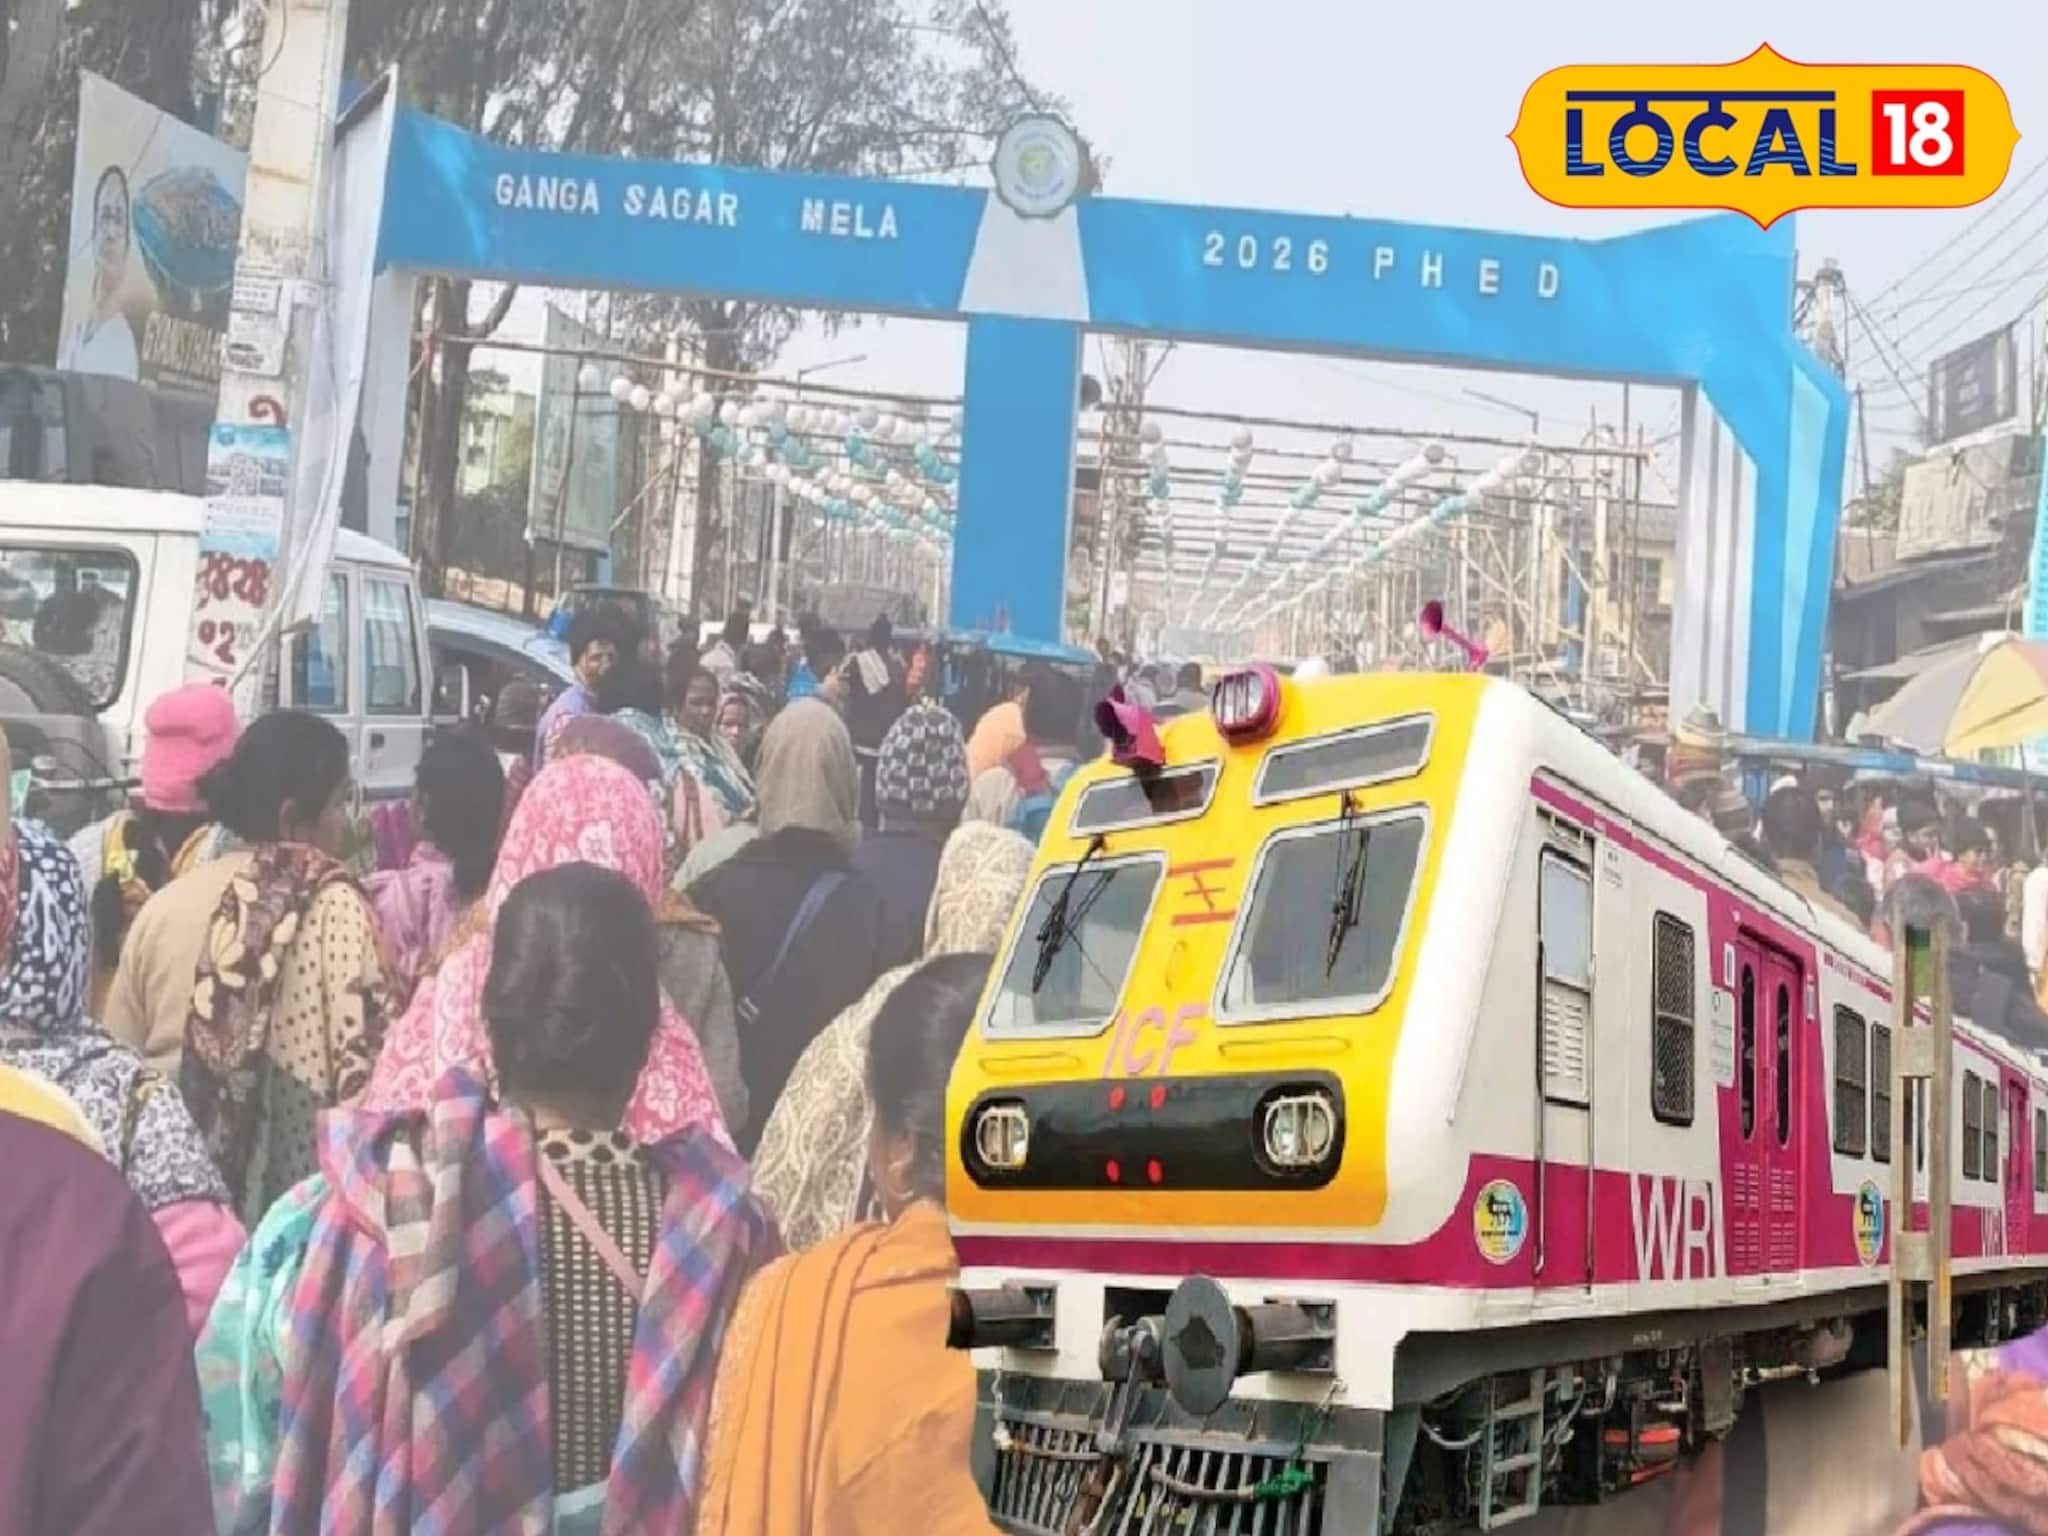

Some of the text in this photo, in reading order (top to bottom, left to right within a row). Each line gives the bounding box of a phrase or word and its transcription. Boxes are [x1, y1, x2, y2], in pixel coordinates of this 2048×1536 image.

[496, 173, 600, 215] GANGA
[623, 184, 738, 227] SAGAR
[801, 198, 898, 238] MELA
[1203, 230, 1329, 275] 2026
[1103, 1003, 1209, 1079] ICF
